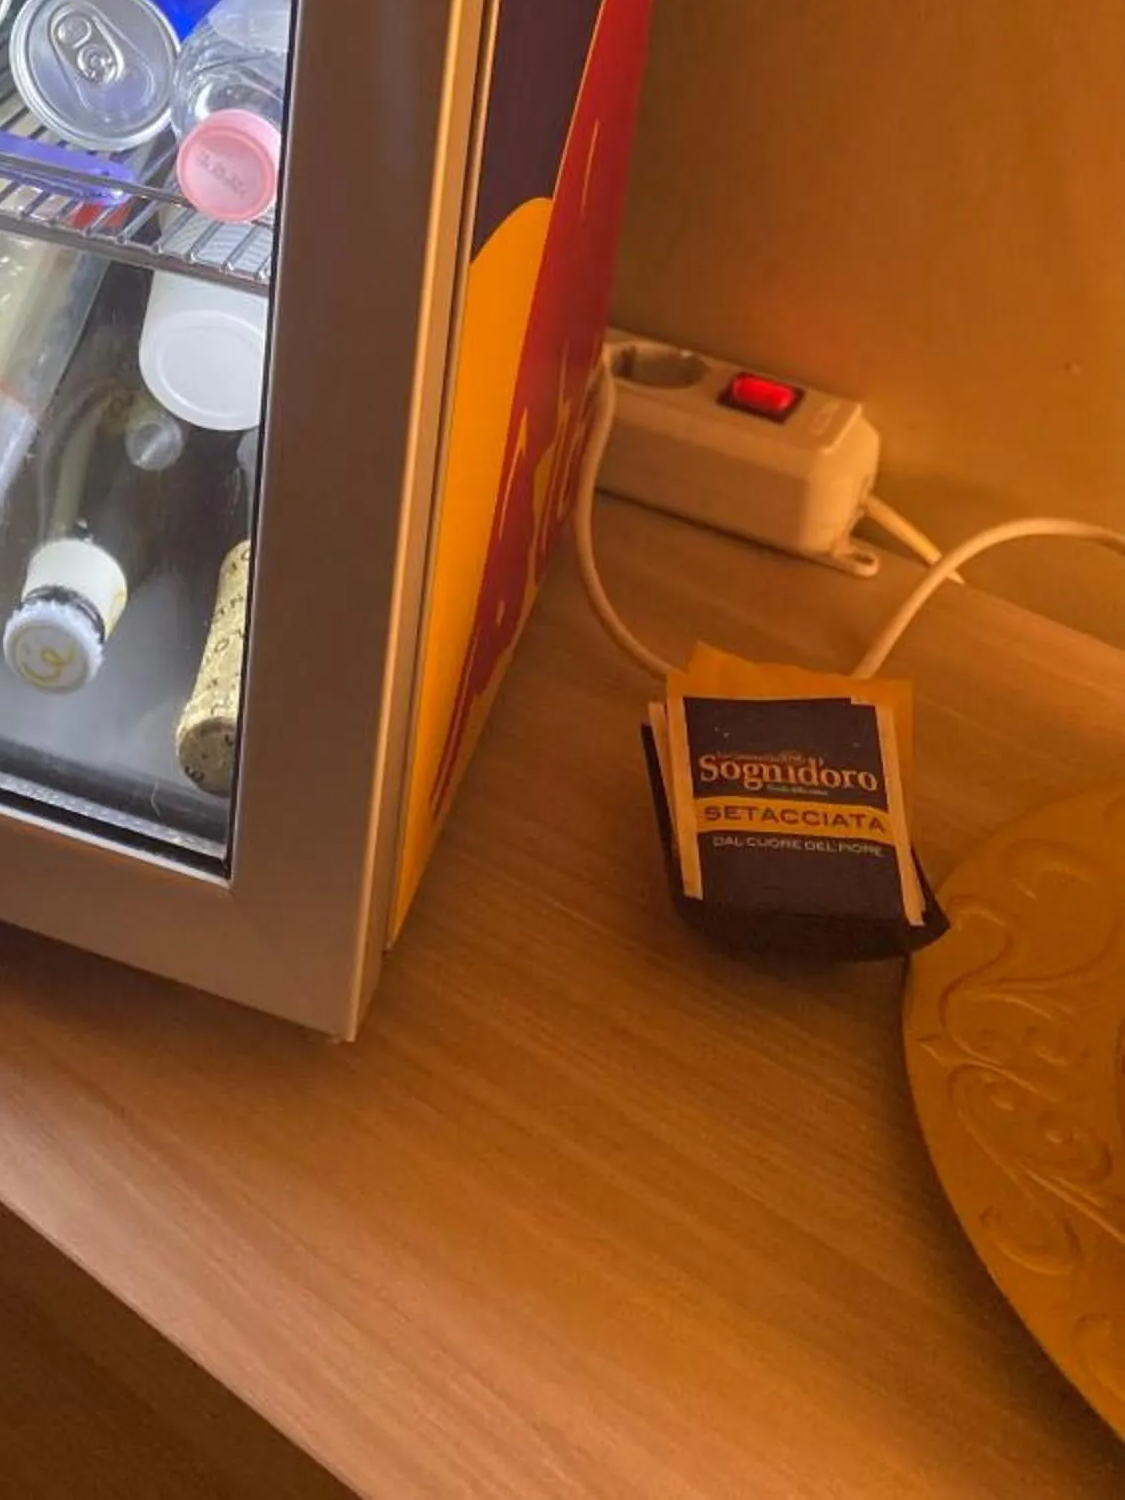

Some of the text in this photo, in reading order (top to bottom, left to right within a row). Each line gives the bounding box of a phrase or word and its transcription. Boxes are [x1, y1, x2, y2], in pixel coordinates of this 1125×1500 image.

[704, 805, 886, 834] SETACCIATA
[713, 835, 743, 848] DAL
[746, 837, 803, 850] CUORE
